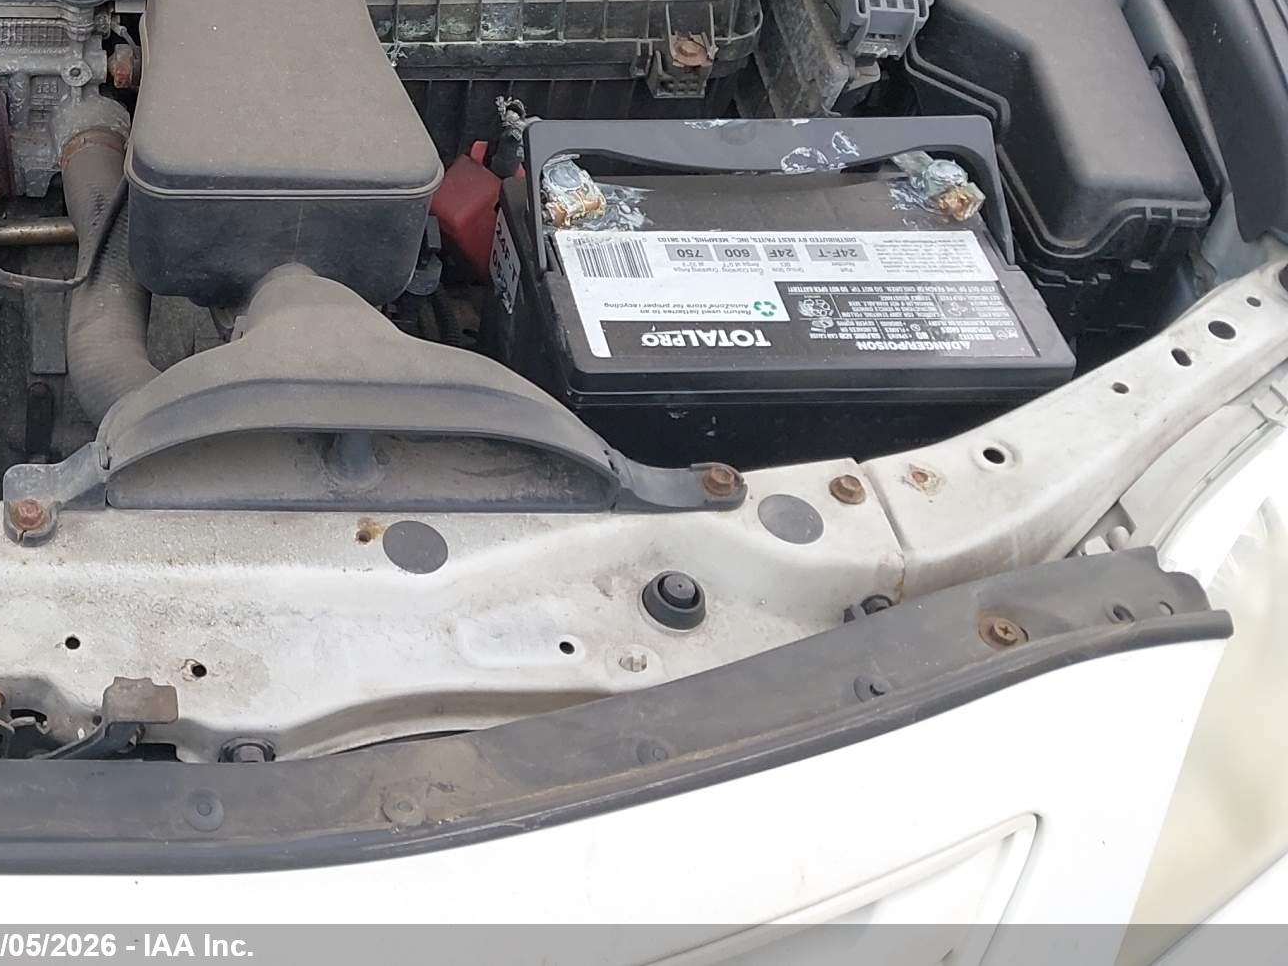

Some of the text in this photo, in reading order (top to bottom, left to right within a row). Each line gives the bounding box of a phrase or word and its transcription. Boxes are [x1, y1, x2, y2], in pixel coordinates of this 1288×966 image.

[676, 249, 704, 258] 750
[724, 249, 751, 258] 600
[768, 249, 794, 258] 24F
[817, 249, 857, 258] 24F-T
